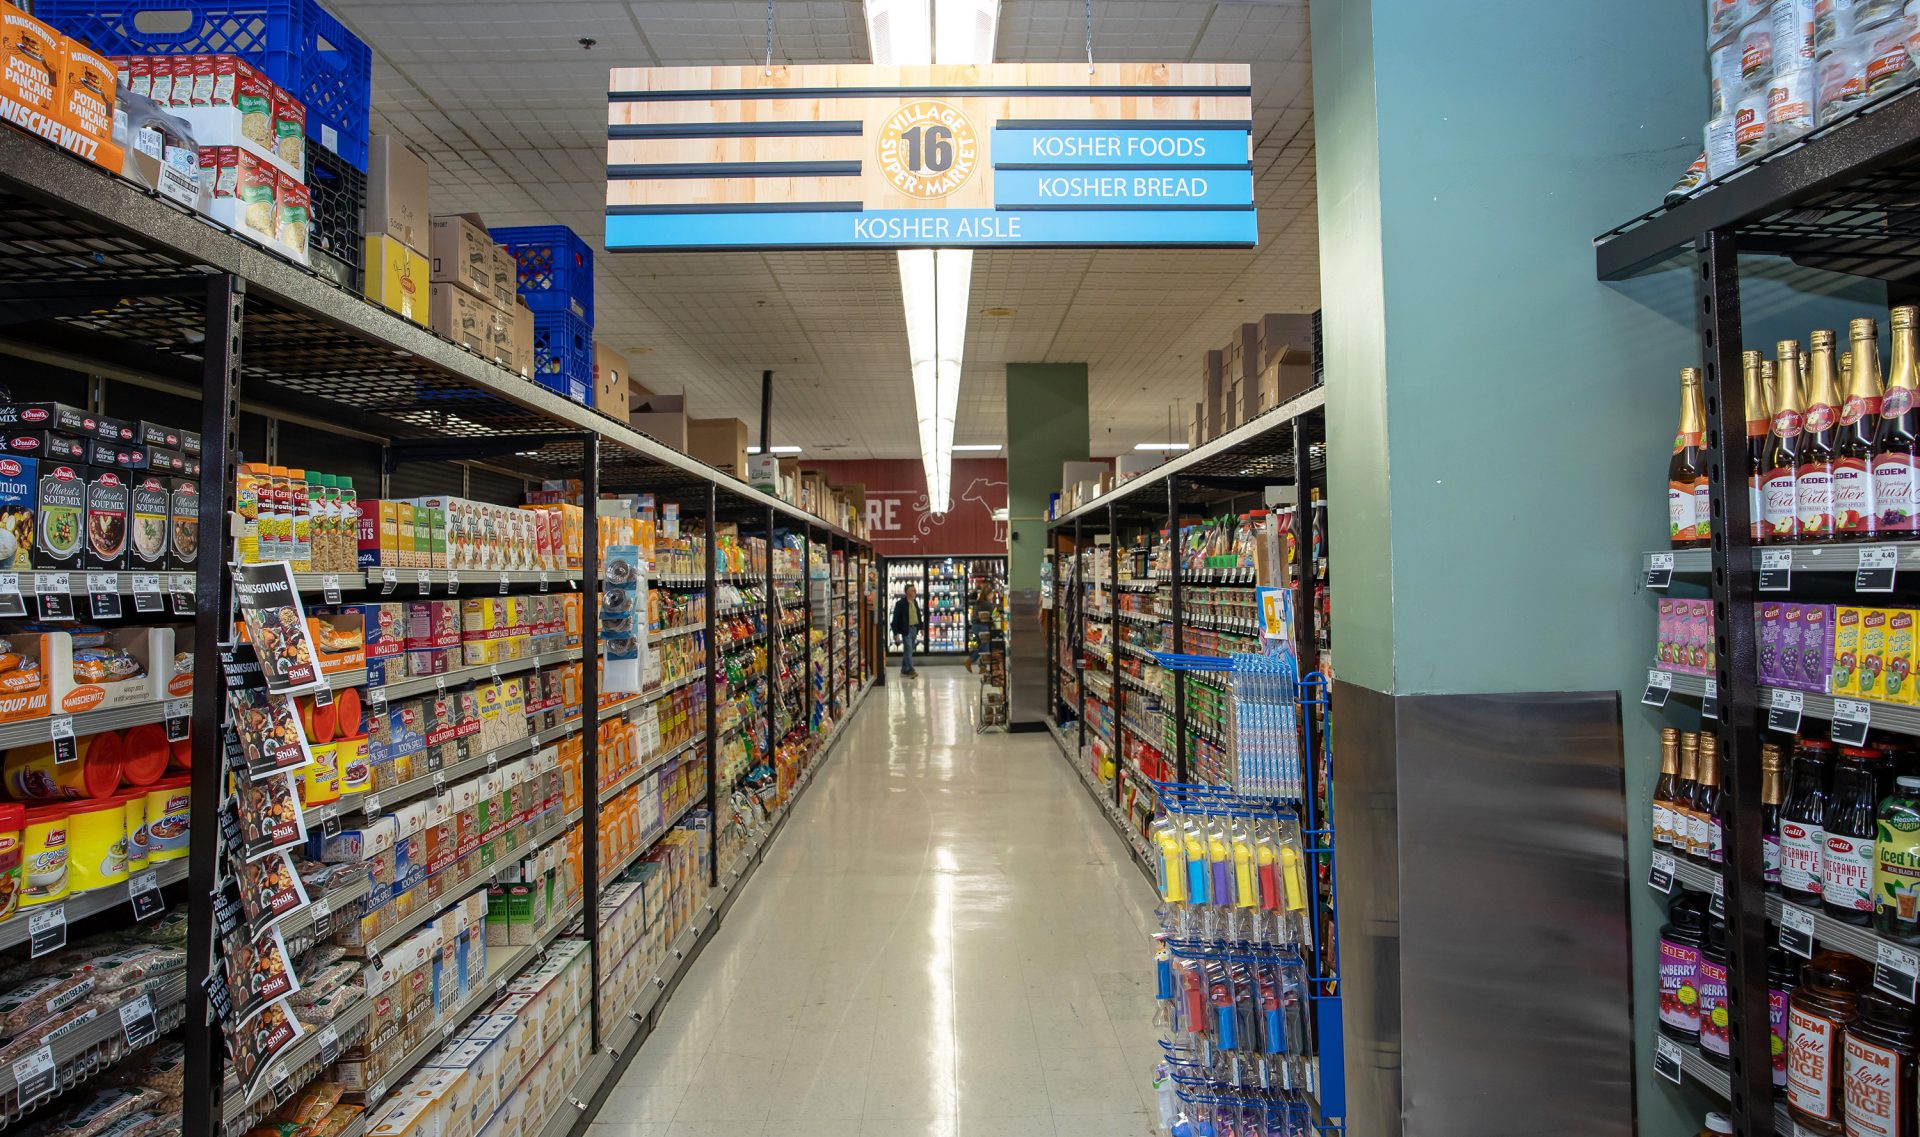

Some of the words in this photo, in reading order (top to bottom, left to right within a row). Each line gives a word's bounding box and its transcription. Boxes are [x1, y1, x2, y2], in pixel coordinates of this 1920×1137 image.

[4, 15, 57, 50] MANISCHEWITZ
[1884, 55, 1905, 64] Large
[10, 56, 49, 86] POTATO
[71, 52, 115, 83] MANISCHEWITZ
[5, 68, 52, 100] PANCAKE
[19, 88, 39, 106] MIX
[74, 90, 107, 116] POTATO
[69, 100, 108, 131] PANCAKE
[888, 104, 966, 132] VILLAGE
[80, 118, 97, 135] MIX
[901, 126, 952, 172] 16
[1032, 137, 1121, 156] KOSHER
[1128, 137, 1206, 156] FOODS
[881, 138, 918, 192] SUPER
[925, 138, 974, 196] MARKET
[1038, 178, 1127, 197] KOSHER
[1134, 178, 1208, 197] BREAD
[854, 218, 949, 238] KOSHER
[956, 217, 1021, 238] AISLE
[46, 482, 80, 496] Muriel's
[92, 488, 124, 500] Muriel's
[44, 496, 66, 504] SOUP
[67, 496, 80, 506] MIX
[91, 500, 109, 509] SOUP
[136, 504, 154, 512] SOUP
[175, 507, 189, 515] SOUP
[236, 581, 288, 594] THANKSGIVING
[1866, 616, 1884, 626] GEFEN
[1892, 617, 1910, 626] GEFEN
[1838, 631, 1858, 639] Apple
[1862, 632, 1884, 642] Apple
[1888, 633, 1912, 642] Apple
[374, 644, 398, 654] UNSALTED
[228, 675, 244, 686] MENU
[28, 694, 48, 709] MIX
[64, 692, 104, 708] MANISCHEWITZ
[399, 742, 411, 752] 100%
[220, 813, 233, 826] 2025
[1784, 826, 1802, 836] Galil
[1828, 840, 1850, 850] Galil
[1834, 856, 1858, 864] ORGANIC
[1881, 847, 1905, 866] Iced
[214, 896, 228, 910] 2025
[220, 918, 238, 935] MENU
[1902, 956, 1914, 966] 5.79
[208, 976, 224, 996] 2025
[54, 993, 70, 1007] PINTO
[70, 981, 90, 998] BEANS
[1794, 1033, 1824, 1054] Light
[38, 1053, 50, 1062] 1.99
[1855, 1066, 1890, 1088] Light
